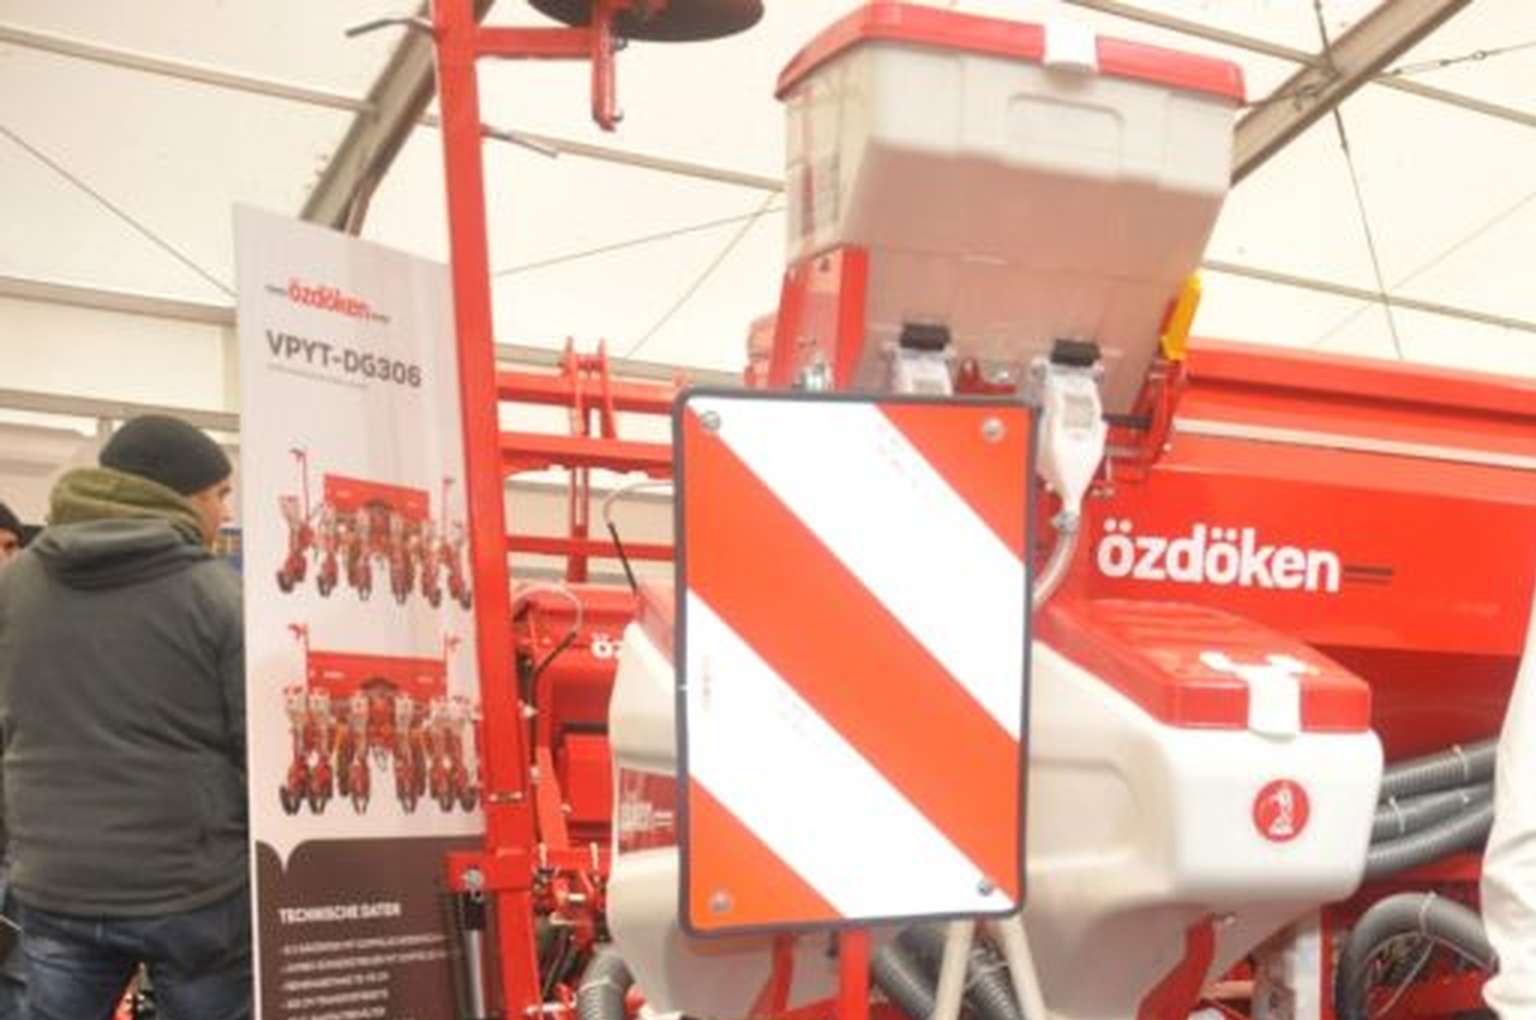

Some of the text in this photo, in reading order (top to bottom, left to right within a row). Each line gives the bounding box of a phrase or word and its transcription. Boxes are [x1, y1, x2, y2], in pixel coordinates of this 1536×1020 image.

[288, 278, 373, 320] özdöken
[266, 329, 422, 388] VPYT-DG306
[1097, 518, 1341, 593] özdöken
[278, 902, 402, 924] TECHNISCHE DATEN
